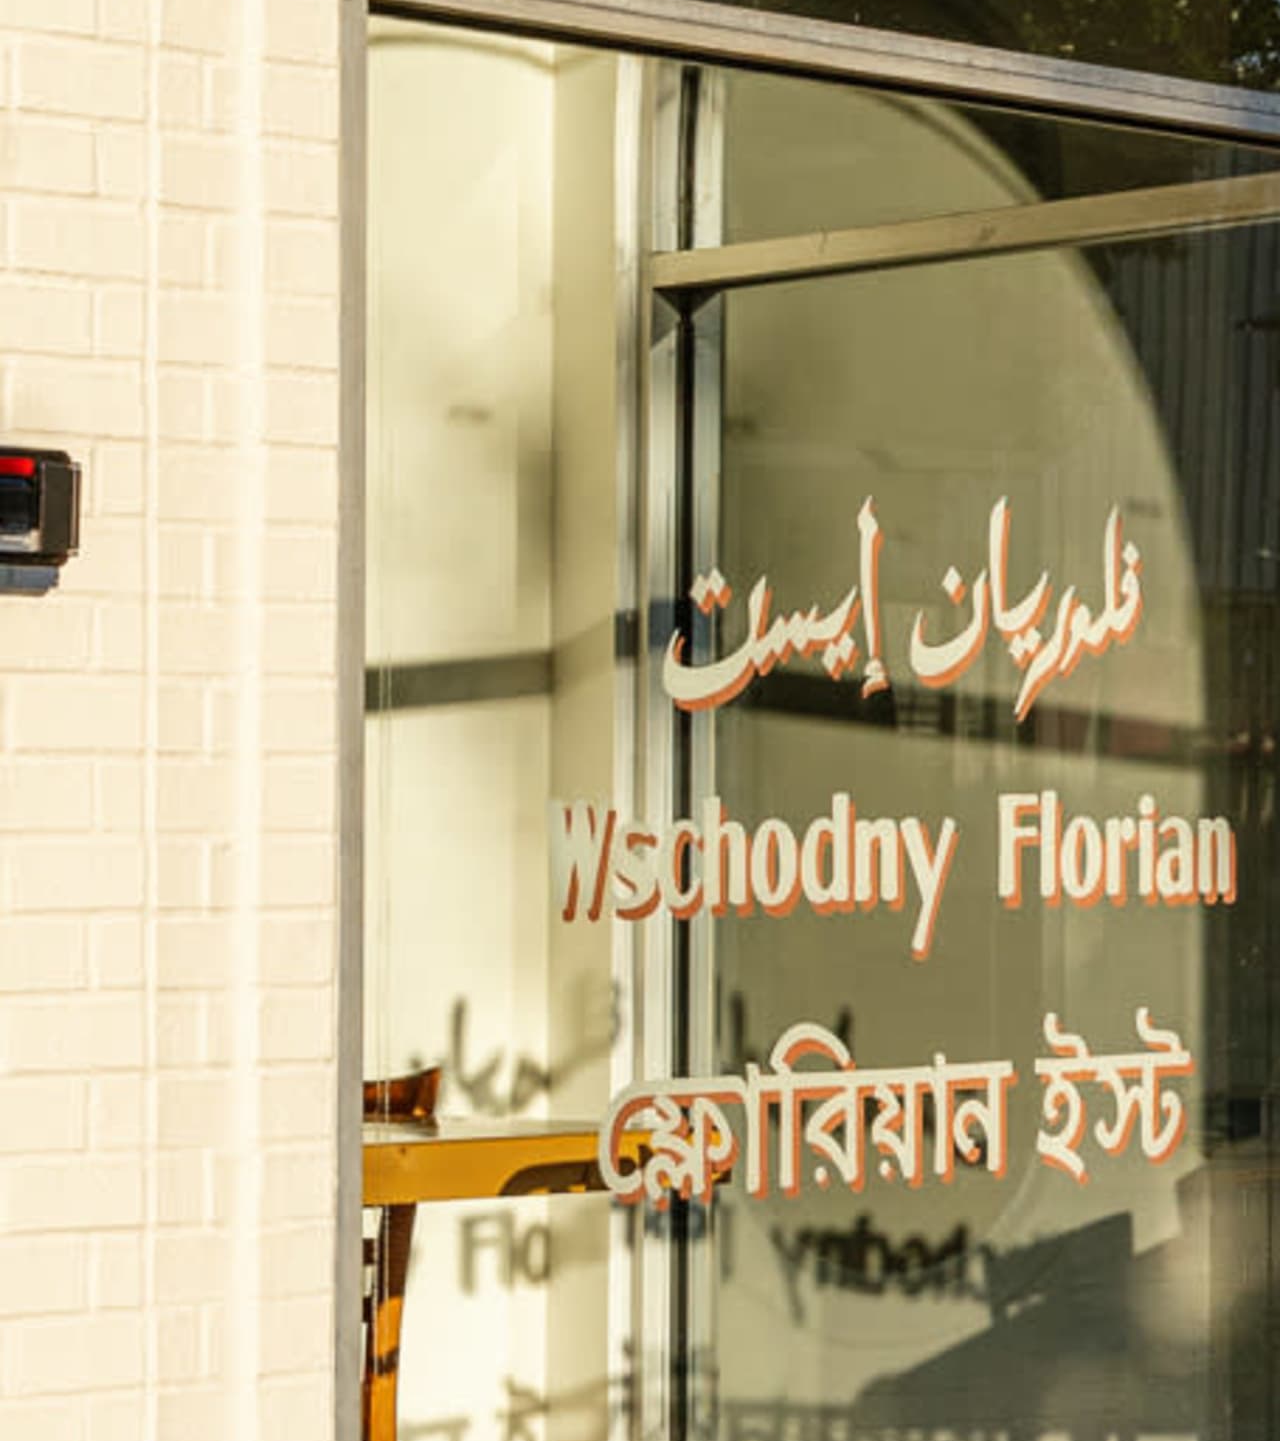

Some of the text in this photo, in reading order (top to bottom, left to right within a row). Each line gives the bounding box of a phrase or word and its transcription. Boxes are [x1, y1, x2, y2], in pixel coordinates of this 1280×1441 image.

[661, 494, 892, 712] إيست
[549, 789, 1237, 961] Wschodny Florian
[599, 1006, 1197, 1212] ফ্লোরিয়ান ইস্ট
